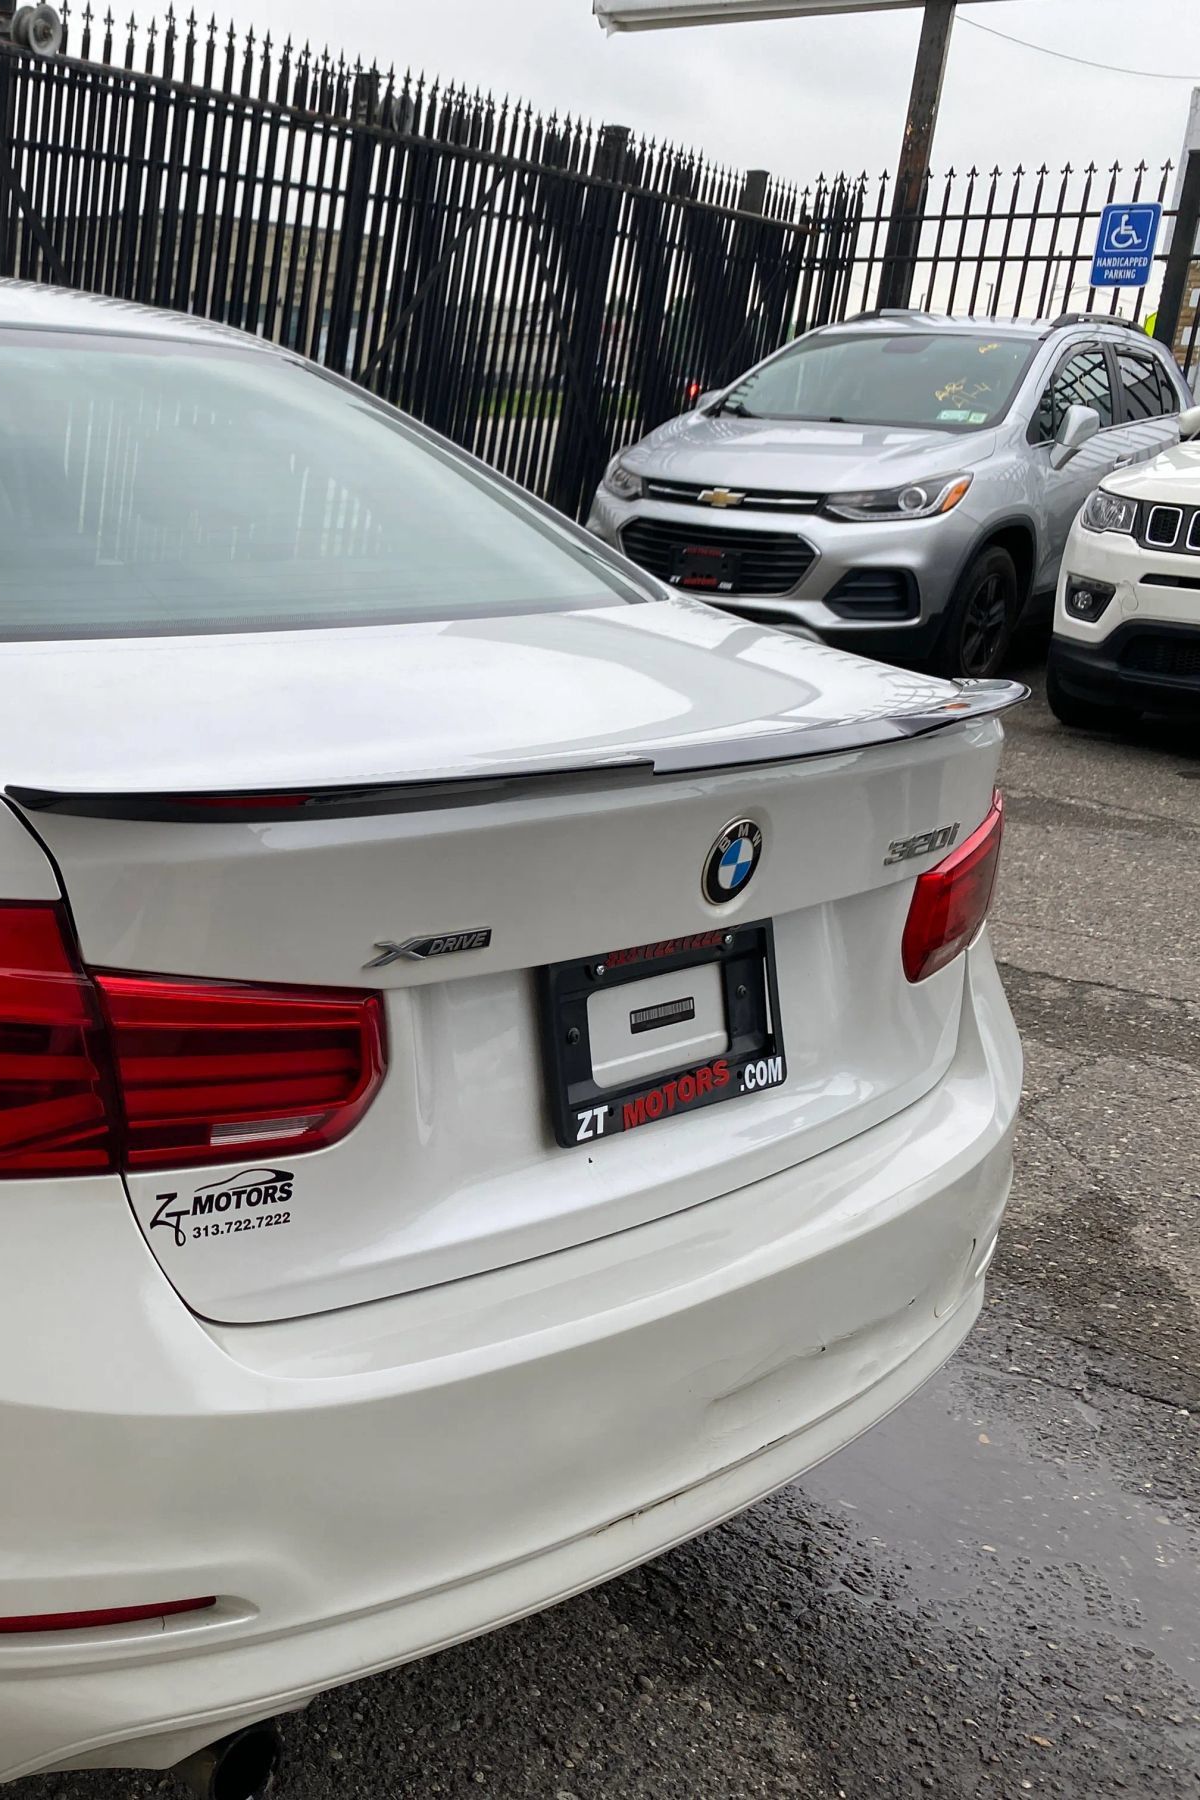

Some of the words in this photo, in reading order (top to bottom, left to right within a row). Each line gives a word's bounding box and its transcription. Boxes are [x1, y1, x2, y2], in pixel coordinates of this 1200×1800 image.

[1096, 256, 1148, 268] HANDICAPPED
[1104, 268, 1137, 280] PARKING
[719, 822, 762, 854] BMW
[883, 821, 961, 867] 320i
[575, 1105, 609, 1142] ZT
[623, 1060, 730, 1132] MOTORS
[740, 1056, 783, 1092] .COM
[191, 1182, 294, 1217] MOTORS
[192, 1211, 292, 1239] 313.722.7222
